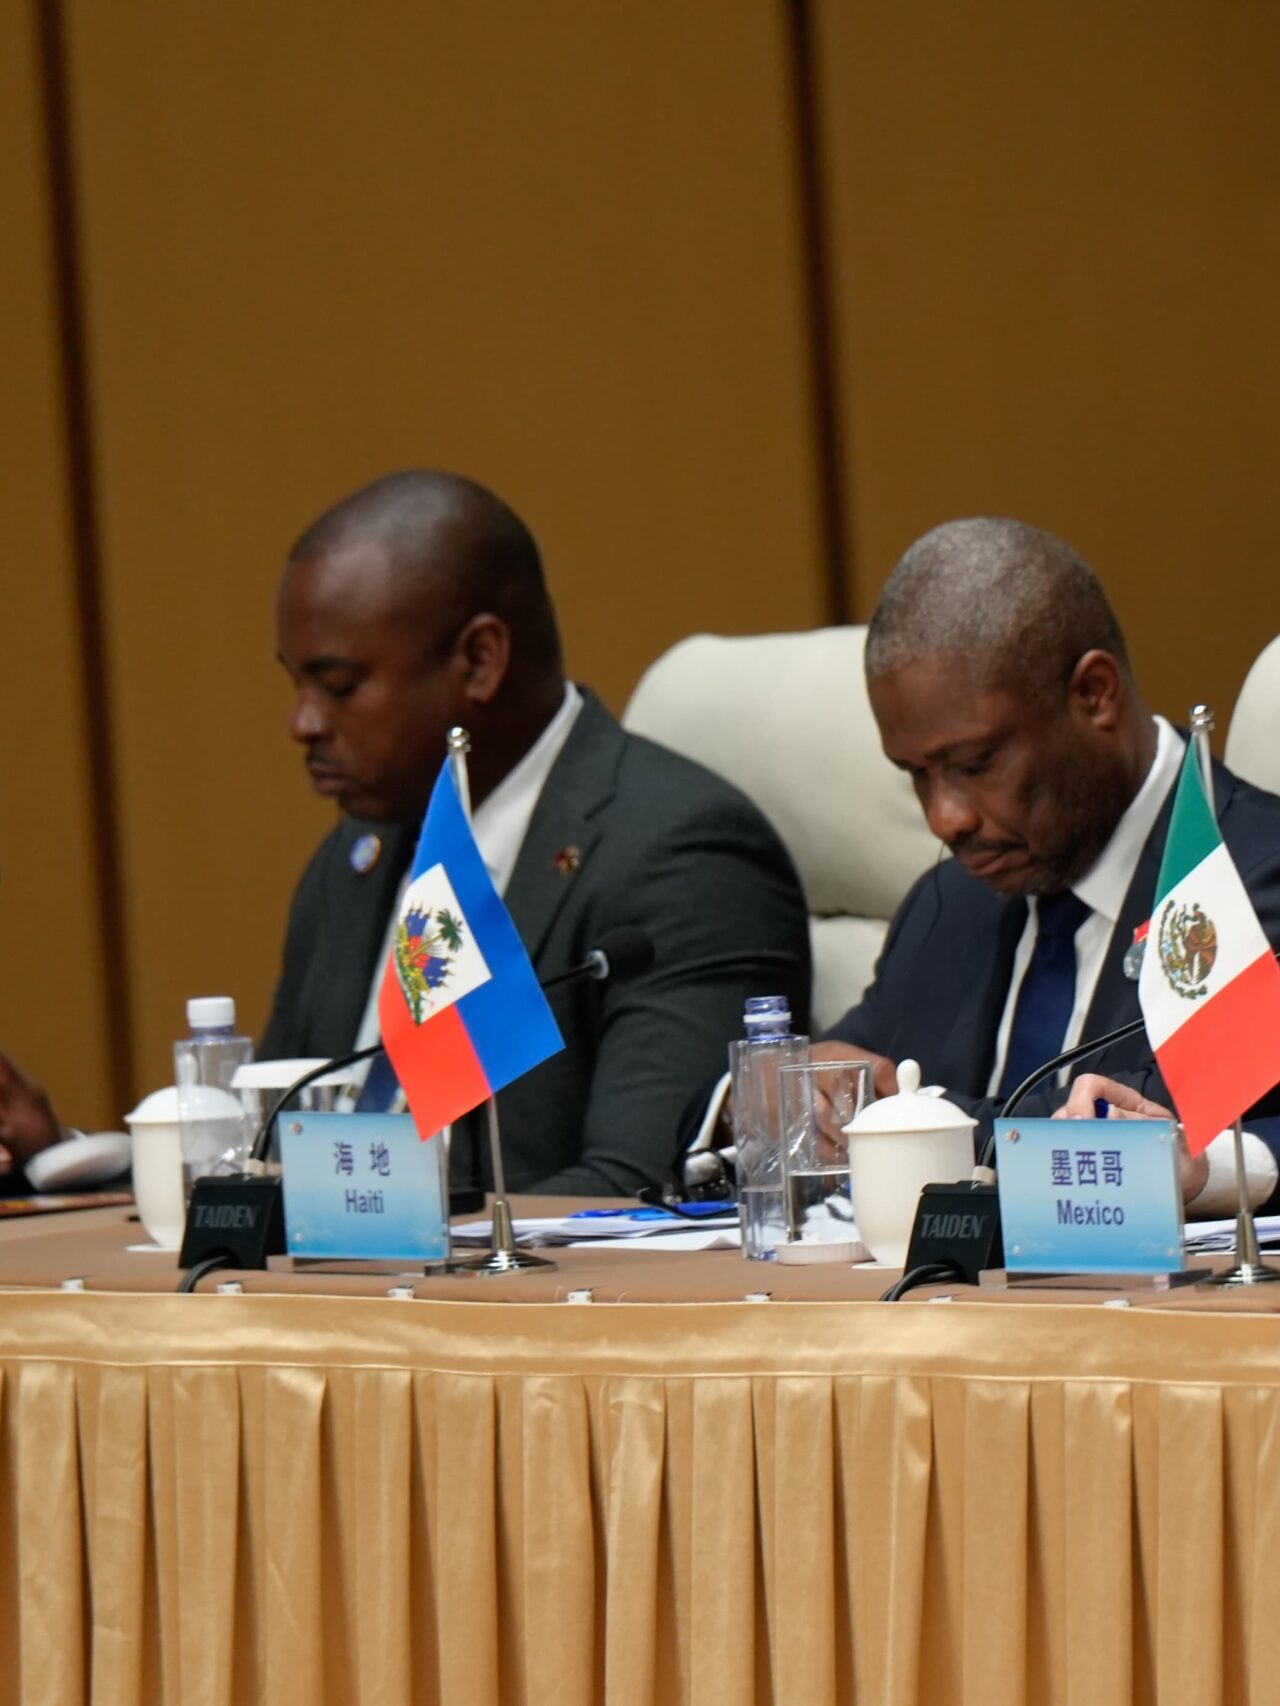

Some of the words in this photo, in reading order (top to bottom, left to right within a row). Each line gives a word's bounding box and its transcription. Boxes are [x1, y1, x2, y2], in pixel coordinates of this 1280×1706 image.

[333, 1141, 391, 1177] 海地
[1051, 1149, 1124, 1187] 墨西哥
[345, 1189, 385, 1214] Haiti
[1056, 1199, 1125, 1226] Mexico
[193, 1205, 258, 1229] TAIDEN
[920, 1213, 984, 1239] TAIDEN
